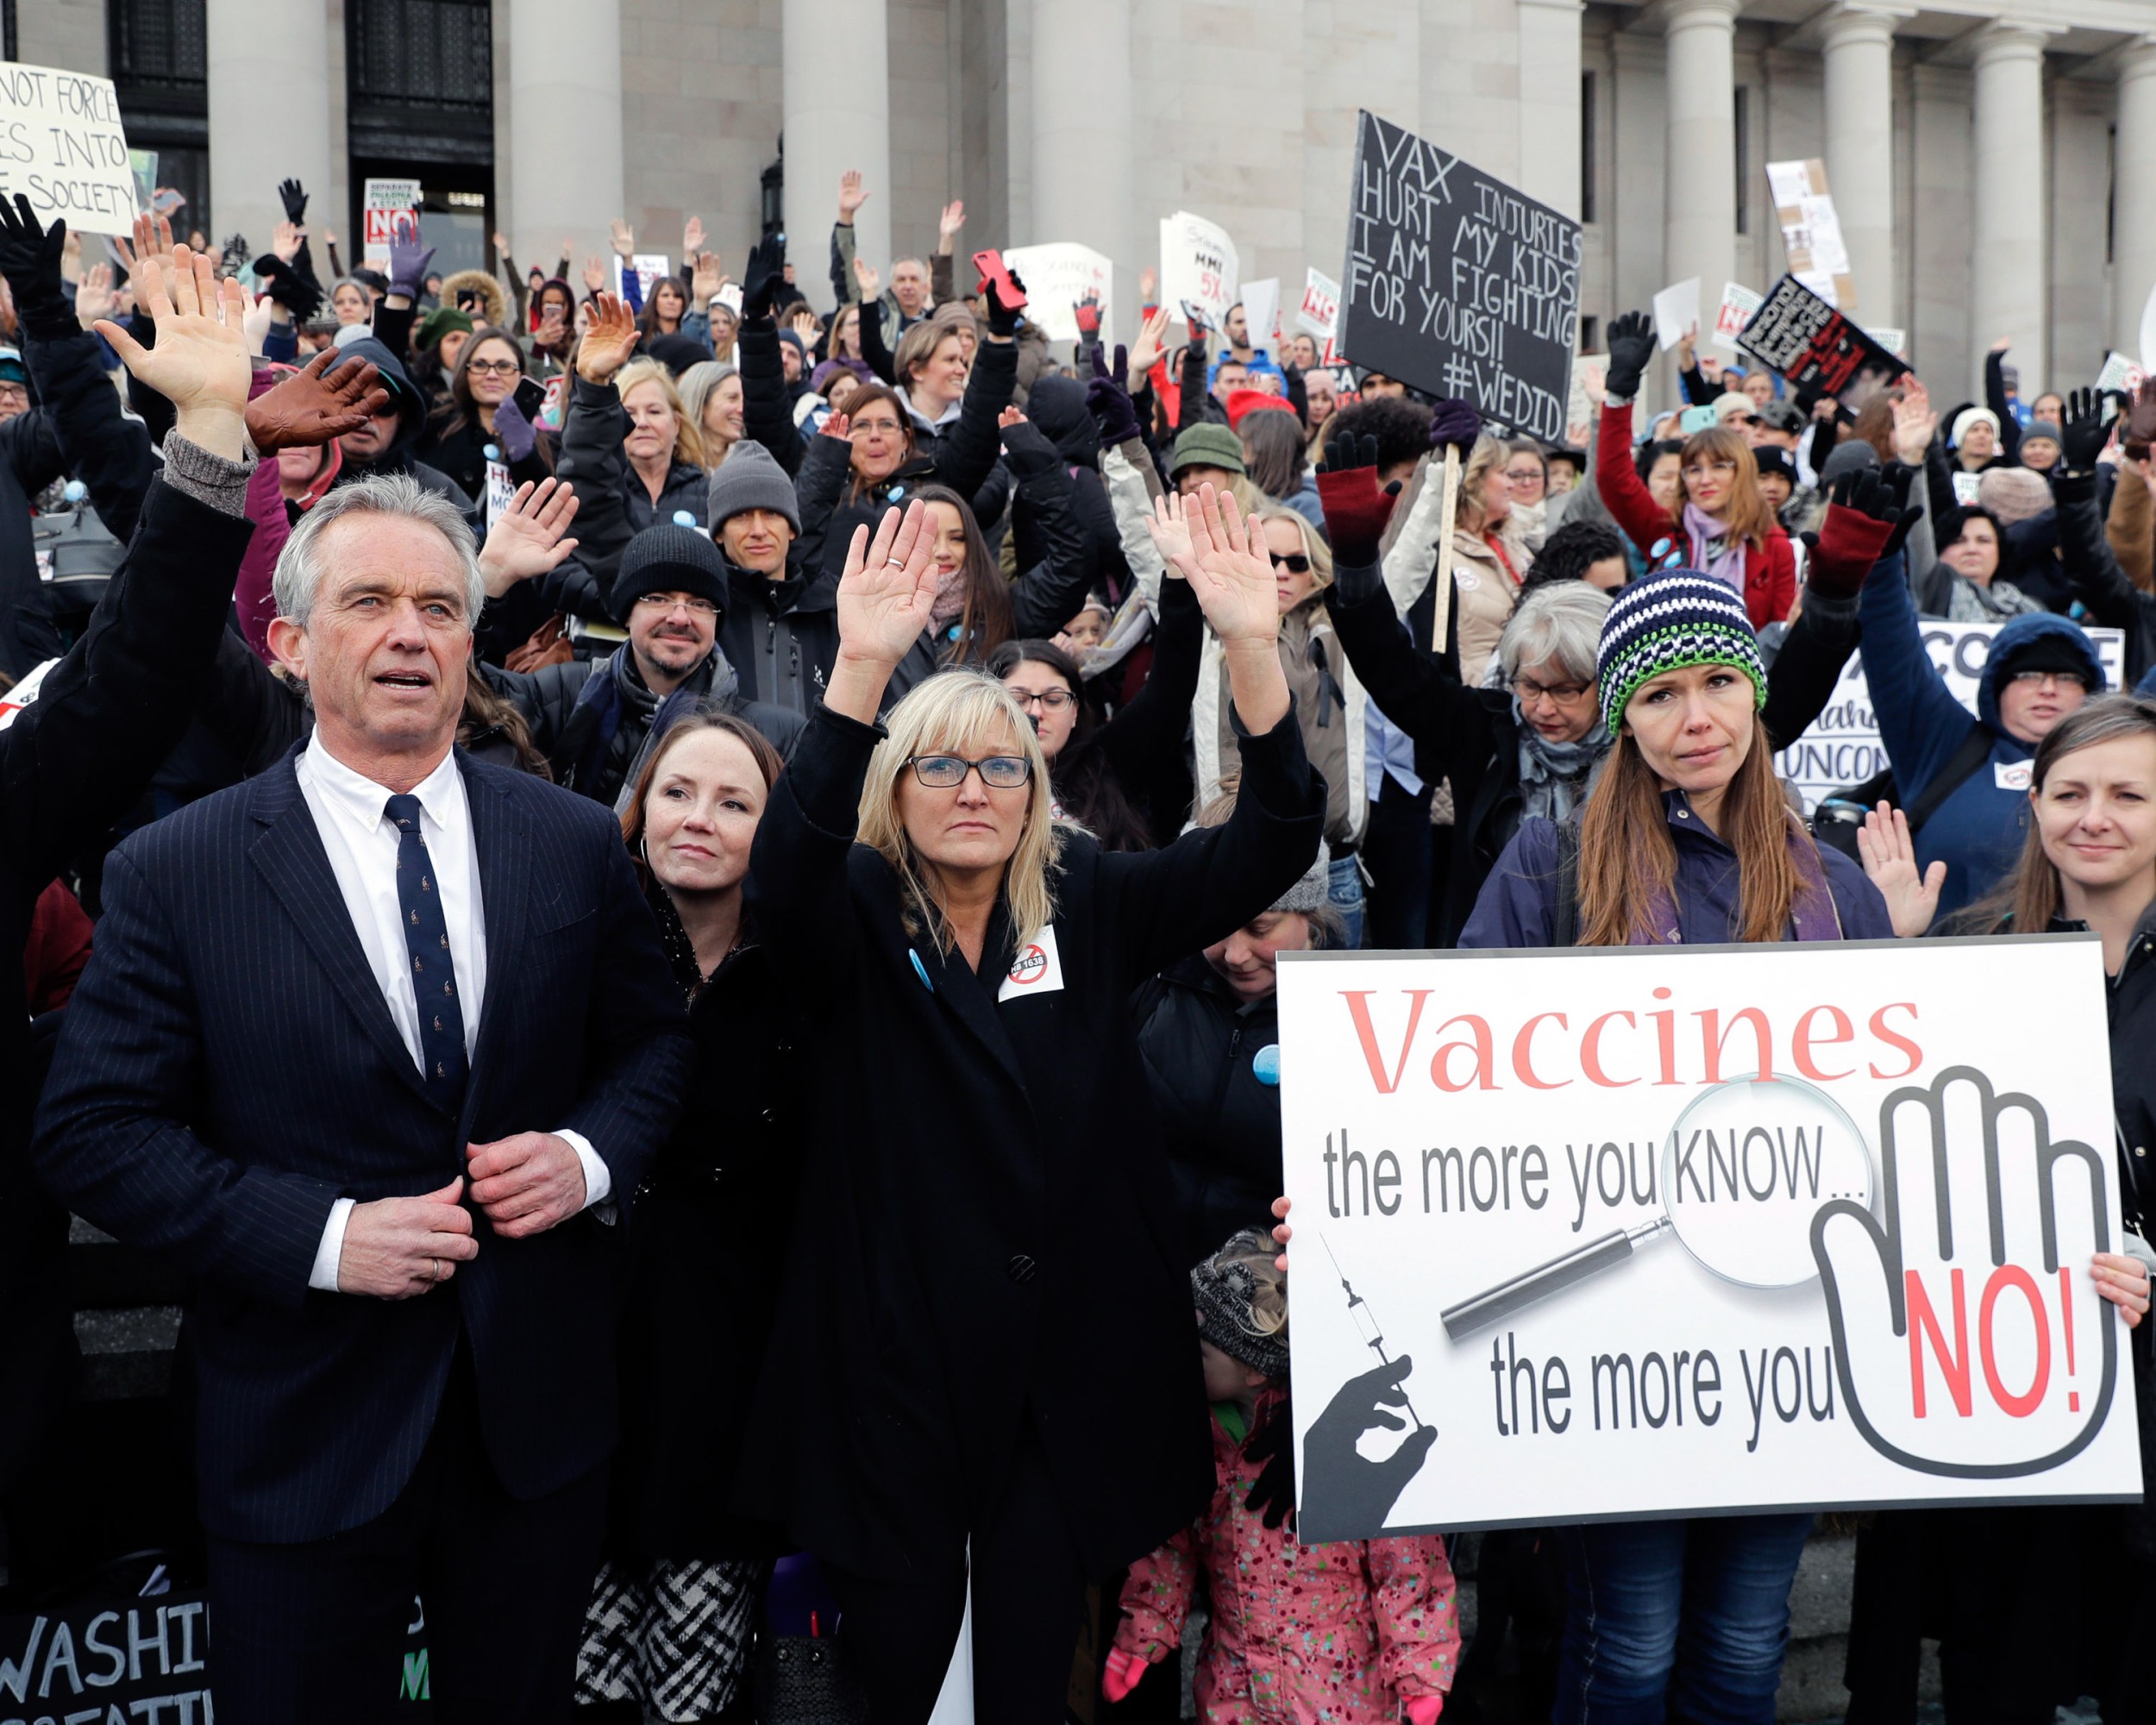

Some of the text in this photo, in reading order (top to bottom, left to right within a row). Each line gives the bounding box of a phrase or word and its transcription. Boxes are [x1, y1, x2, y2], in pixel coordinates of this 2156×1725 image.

[49, 128, 126, 169] INTO
[57, 76, 122, 125] FORCE
[28, 174, 135, 222] SOCIETY
[1362, 160, 1440, 242] HURT
[1452, 215, 1499, 269] MY
[1372, 115, 1583, 268] VAX INJURIES
[1350, 260, 1505, 371] FOR YOURS!!
[1353, 212, 1379, 265] I
[1387, 229, 1432, 289] AM
[1452, 256, 1577, 348] FIGHTING
[1443, 352, 1563, 442] #WEDID
[1023, 956, 1044, 969] 1638
[1337, 988, 1923, 1094] Vaccines
[1324, 1129, 1402, 1219] the
[1422, 1140, 1549, 1215] more
[1566, 1141, 1656, 1232] you
[1490, 1264, 2080, 1452] the more you NO!
